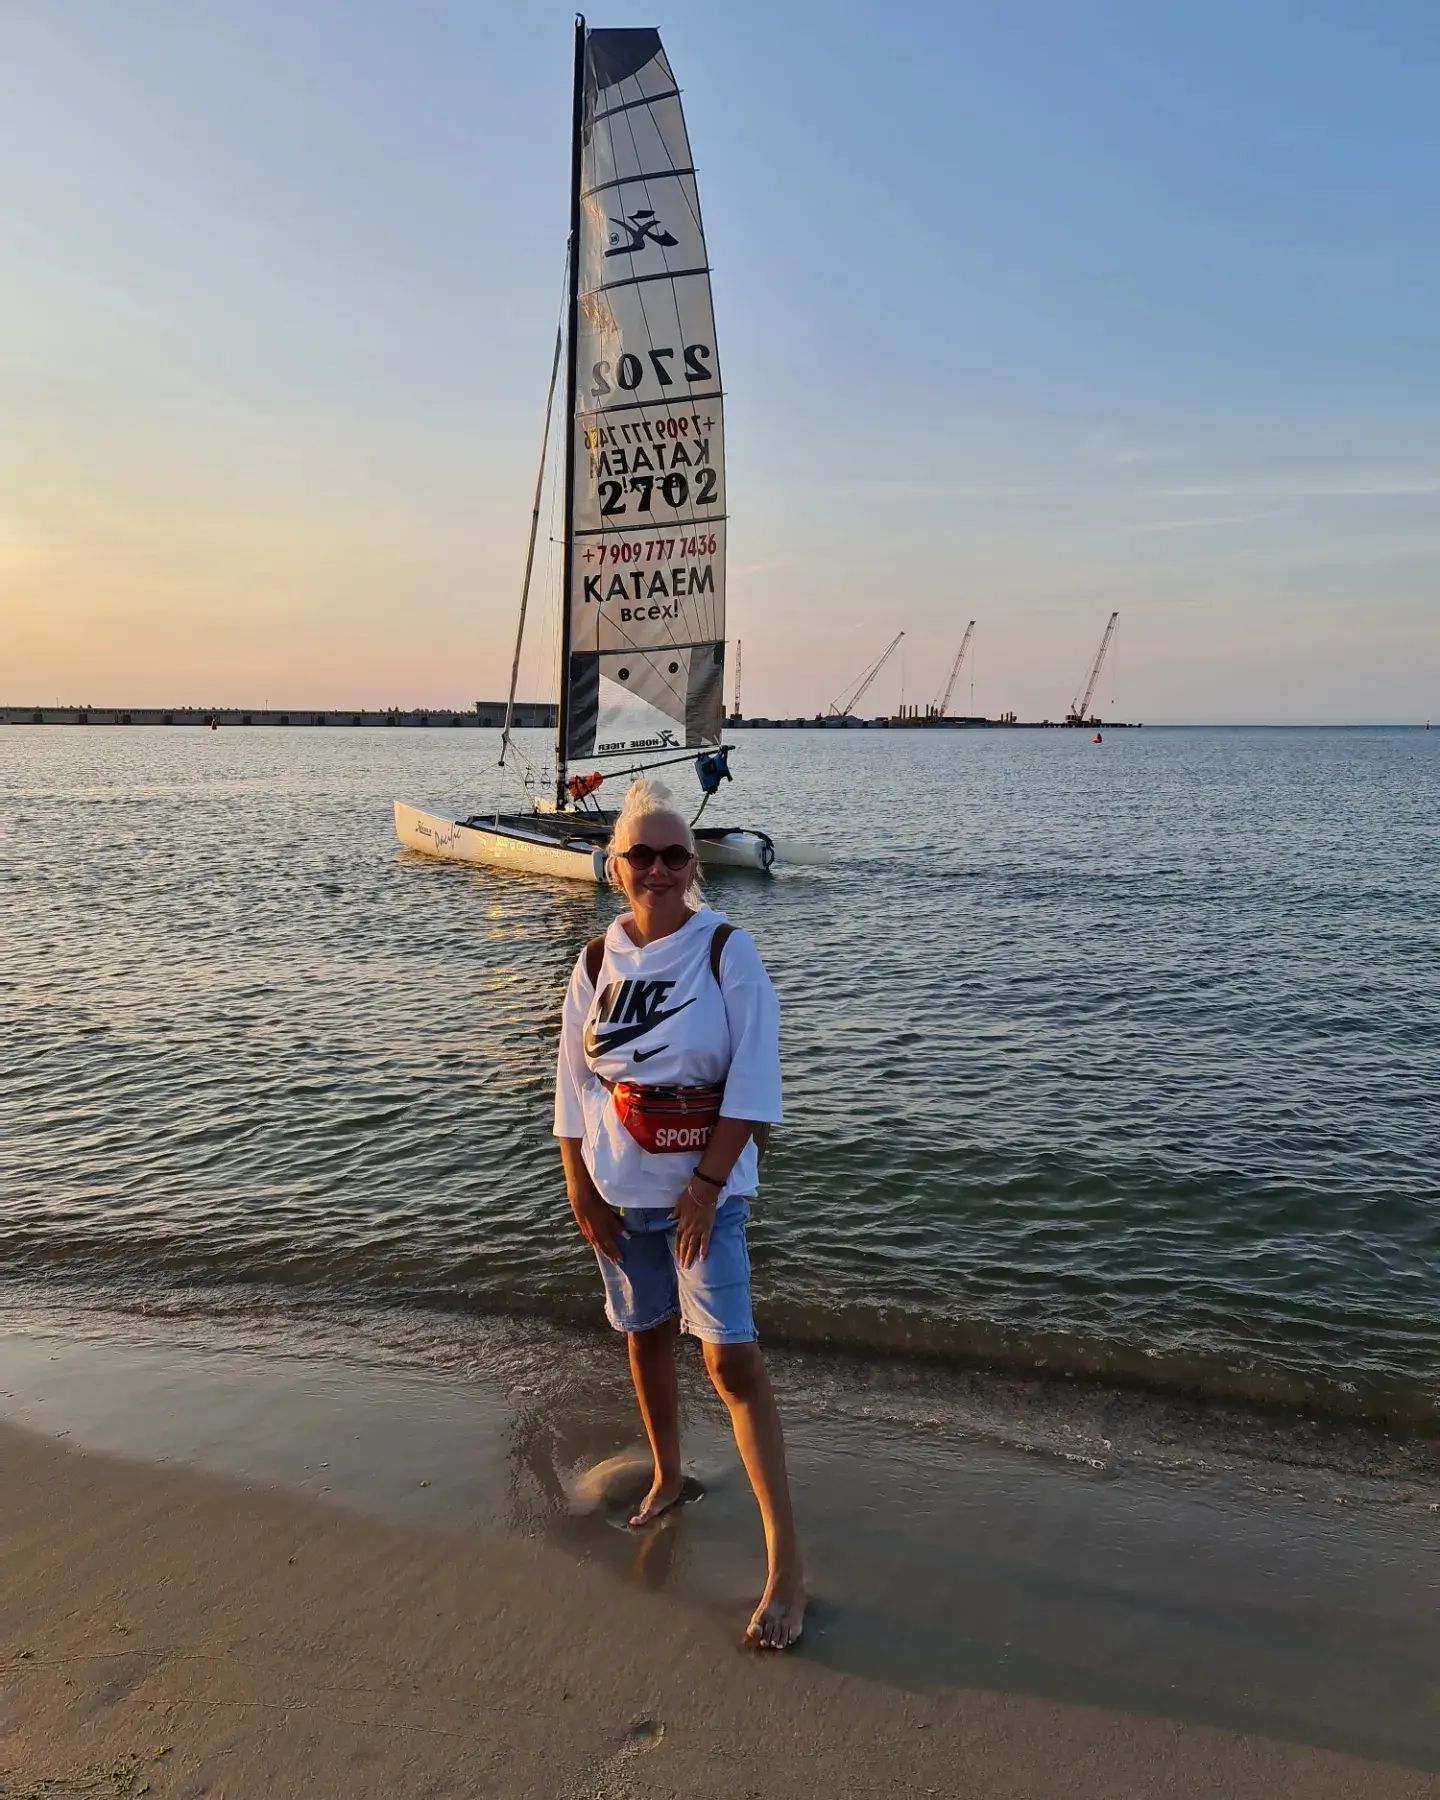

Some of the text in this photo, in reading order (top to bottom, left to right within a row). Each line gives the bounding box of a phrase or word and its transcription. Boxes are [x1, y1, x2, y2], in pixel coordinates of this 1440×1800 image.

[597, 467, 718, 516] 2702
[582, 533, 718, 566] +7 909 777 7436
[583, 565, 715, 603] КАТАЕМ
[620, 598, 680, 622] всех!
[596, 979, 677, 1024] NIKE
[655, 1125, 714, 1147] SPORT
